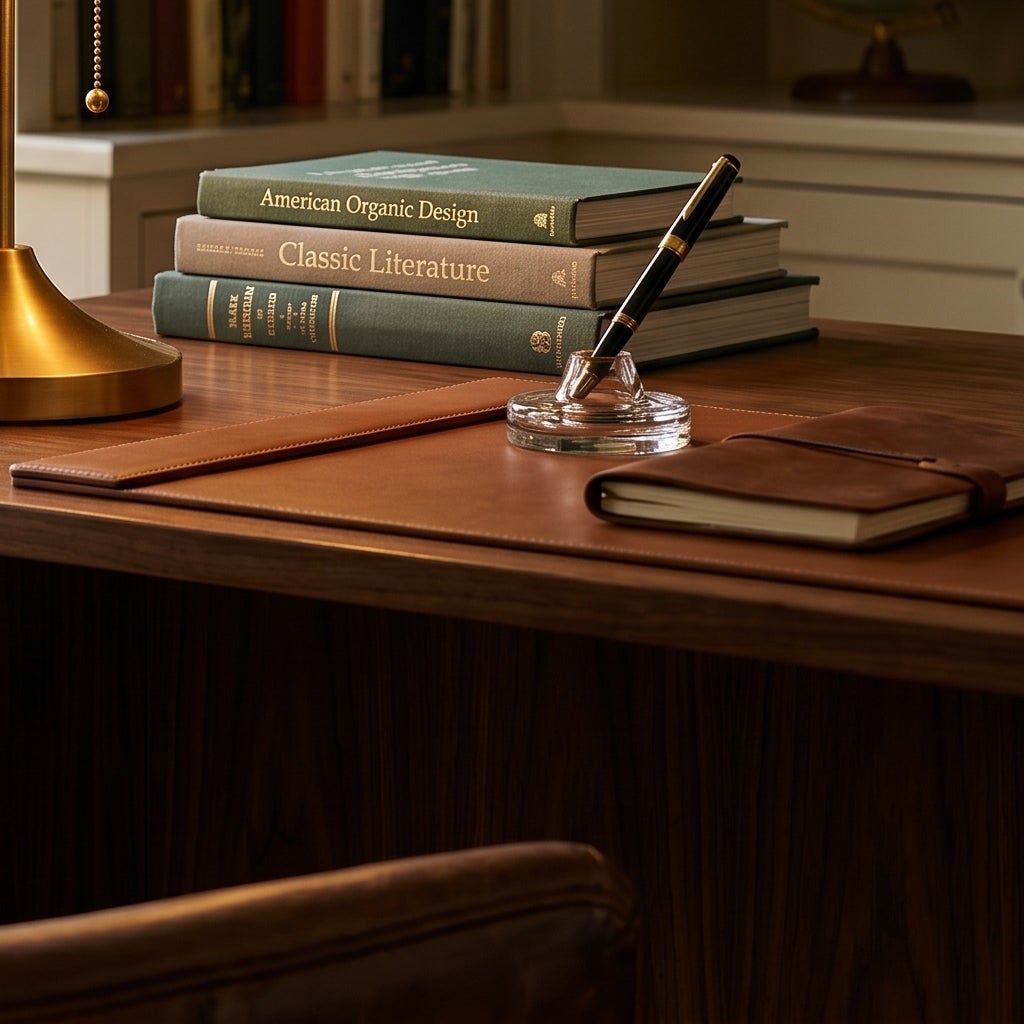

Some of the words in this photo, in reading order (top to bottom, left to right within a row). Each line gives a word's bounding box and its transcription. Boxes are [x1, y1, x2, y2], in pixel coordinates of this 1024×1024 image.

[260, 188, 341, 213] American
[346, 194, 414, 221] Organic
[418, 200, 479, 229] Design
[279, 241, 361, 271] Classic
[369, 248, 490, 283] Literature
